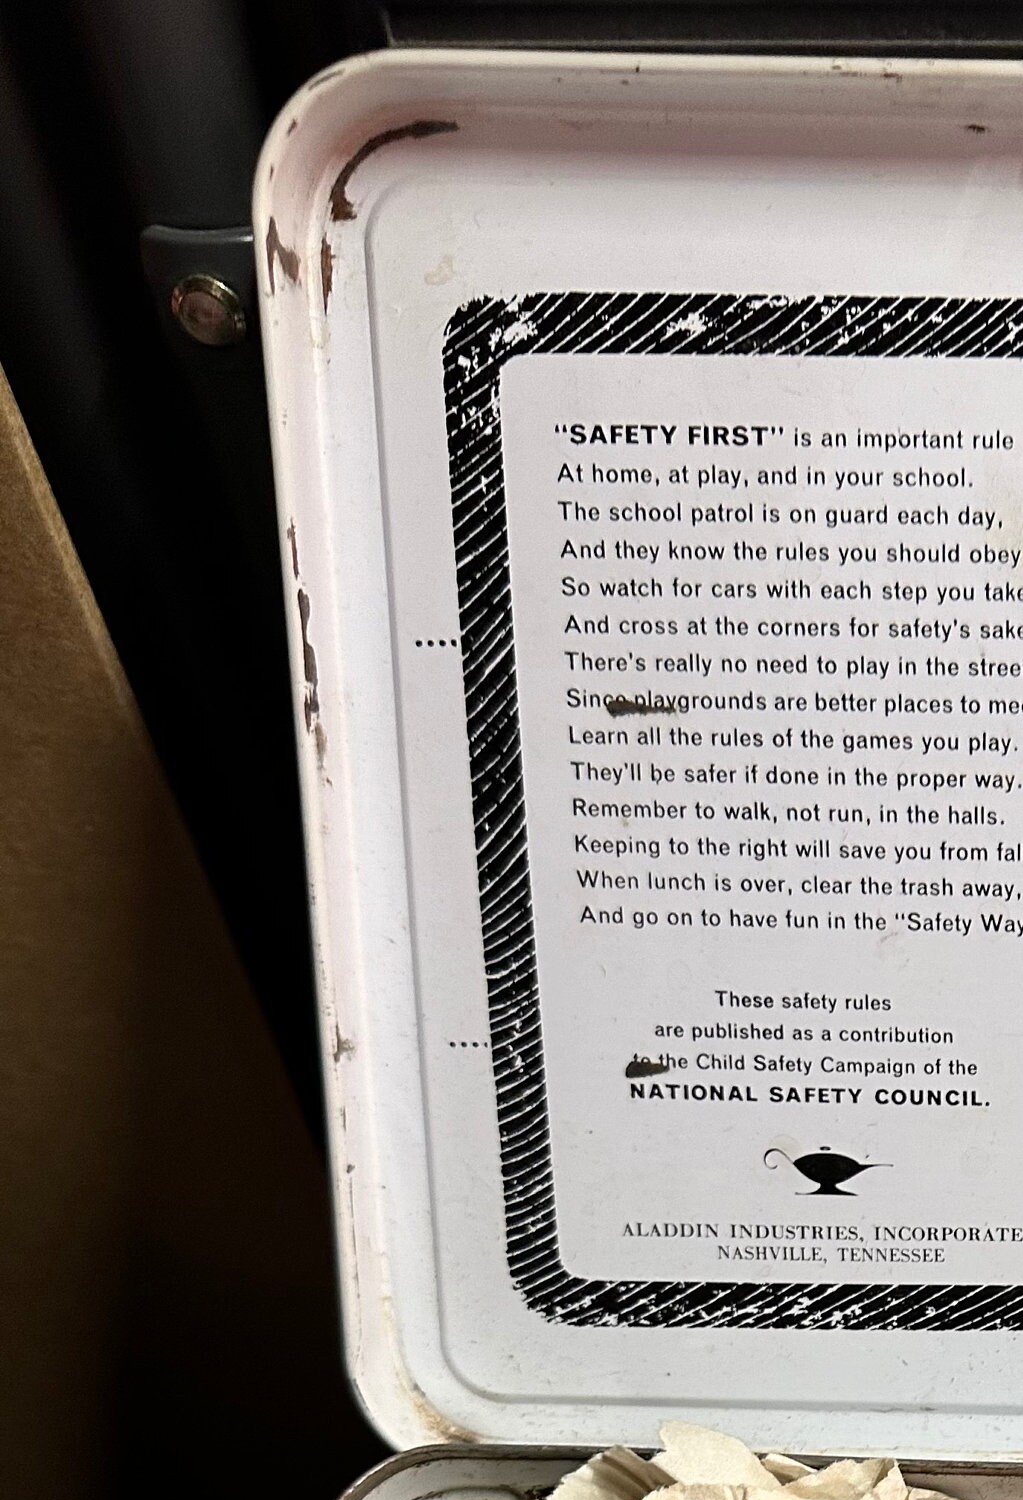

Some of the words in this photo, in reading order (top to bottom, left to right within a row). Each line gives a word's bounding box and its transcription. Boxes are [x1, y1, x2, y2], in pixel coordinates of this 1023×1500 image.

[794, 427, 812, 447] is
[821, 432, 847, 448] an
[857, 428, 963, 453] important
[972, 429, 1014, 450] rule
[557, 463, 584, 484] At
[592, 463, 660, 487] home,
[668, 465, 689, 485] at
[697, 464, 749, 490] play,
[757, 464, 797, 485] and
[807, 466, 826, 486] in
[835, 471, 884, 491] your
[893, 466, 973, 488] school.
[557, 500, 600, 522] The
[609, 501, 682, 522] school
[691, 502, 753, 528] patrol
[762, 503, 780, 523] is
[789, 508, 816, 524] on
[825, 504, 888, 529] guard
[897, 504, 949, 526] each
[957, 505, 1003, 531] day,
[560, 539, 606, 560] And
[614, 539, 660, 564] they
[668, 540, 725, 561] know
[733, 540, 767, 561] the
[776, 541, 830, 562] rules
[838, 546, 877, 566] you
[886, 542, 960, 563] should
[561, 575, 591, 597] So
[599, 577, 663, 598] watch
[672, 577, 702, 598] for
[711, 583, 757, 599] cars
[766, 578, 811, 599] with
[820, 579, 872, 600] each
[882, 580, 928, 606] step
[937, 586, 975, 606] you
[564, 613, 610, 635] And
[618, 620, 679, 635] cross
[687, 616, 707, 636] at
[715, 615, 749, 636] the
[757, 621, 841, 637] corners
[849, 616, 880, 638] for
[888, 617, 971, 644] safety's
[564, 650, 646, 672] There's
[655, 653, 712, 678] really
[721, 658, 747, 673] no
[756, 653, 808, 674] need
[816, 655, 838, 674] to
[846, 655, 890, 680] play
[898, 655, 917, 676] in
[926, 656, 959, 677] the
[634, 689, 768, 714] playgrounds
[774, 696, 808, 711] are
[815, 692, 877, 713] better
[884, 693, 953, 718] places
[960, 695, 981, 714] to
[568, 725, 629, 745] Learn
[637, 726, 661, 746] all
[668, 726, 703, 746] the
[711, 727, 764, 748] rules
[772, 727, 793, 748] of
[800, 728, 834, 749] the
[842, 734, 913, 754] games
[921, 735, 959, 755] you
[968, 731, 1018, 757] play.
[570, 760, 642, 787] They'll
[650, 762, 676, 785] be
[684, 762, 737, 784] safer
[745, 764, 758, 784] if
[765, 764, 819, 786] done
[827, 765, 846, 786] in
[854, 766, 888, 786] the
[896, 773, 967, 792] proper
[974, 774, 1022, 793] way.
[572, 797, 687, 819] Remember
[694, 801, 715, 820] to
[723, 800, 778, 825] walk,
[786, 803, 821, 822] not
[828, 808, 871, 826] run,
[879, 808, 898, 824] in
[906, 804, 940, 825] the
[948, 805, 1005, 825] halls.
[574, 834, 660, 859] Keeping
[668, 837, 689, 855] to
[697, 836, 731, 857] the
[738, 837, 788, 862] right
[795, 839, 830, 858] will
[839, 845, 886, 860] save
[894, 846, 931, 865] you
[939, 840, 988, 862] from
[576, 869, 639, 890] When
[648, 871, 706, 892] lunch
[714, 877, 732, 892] is
[740, 877, 793, 896] over,
[801, 874, 853, 895] clear
[860, 875, 893, 896] the
[900, 876, 954, 897] trash
[962, 883, 1021, 902] away,
[579, 905, 624, 924] And
[632, 911, 659, 930] go
[667, 911, 693, 927] on
[700, 908, 721, 927] to
[729, 908, 778, 929] have
[785, 908, 819, 929] fun
[827, 915, 846, 930] in
[854, 911, 887, 931] the
[714, 989, 774, 1009] These
[781, 991, 837, 1014] safety
[845, 993, 892, 1011] rules
[654, 1024, 684, 1038] are
[691, 1022, 784, 1043] published
[792, 1028, 814, 1041] as
[821, 1028, 832, 1042] a
[838, 1026, 954, 1044] contribution
[658, 1053, 688, 1070] the
[695, 1052, 745, 1071] Child
[753, 1054, 812, 1077] Safety
[820, 1056, 915, 1078] Campaign
[923, 1058, 942, 1075] of
[948, 1058, 978, 1076] the
[630, 1083, 758, 1102] NATIONAL
[769, 1086, 862, 1105] SAFETY
[874, 1088, 990, 1107] COUNCIL.
[623, 1222, 718, 1239] ALADDIN
[730, 1224, 864, 1242] INDUSTRIES,
[717, 1245, 828, 1265] NASHVILLE,
[836, 1247, 945, 1263] TENNESSEE
